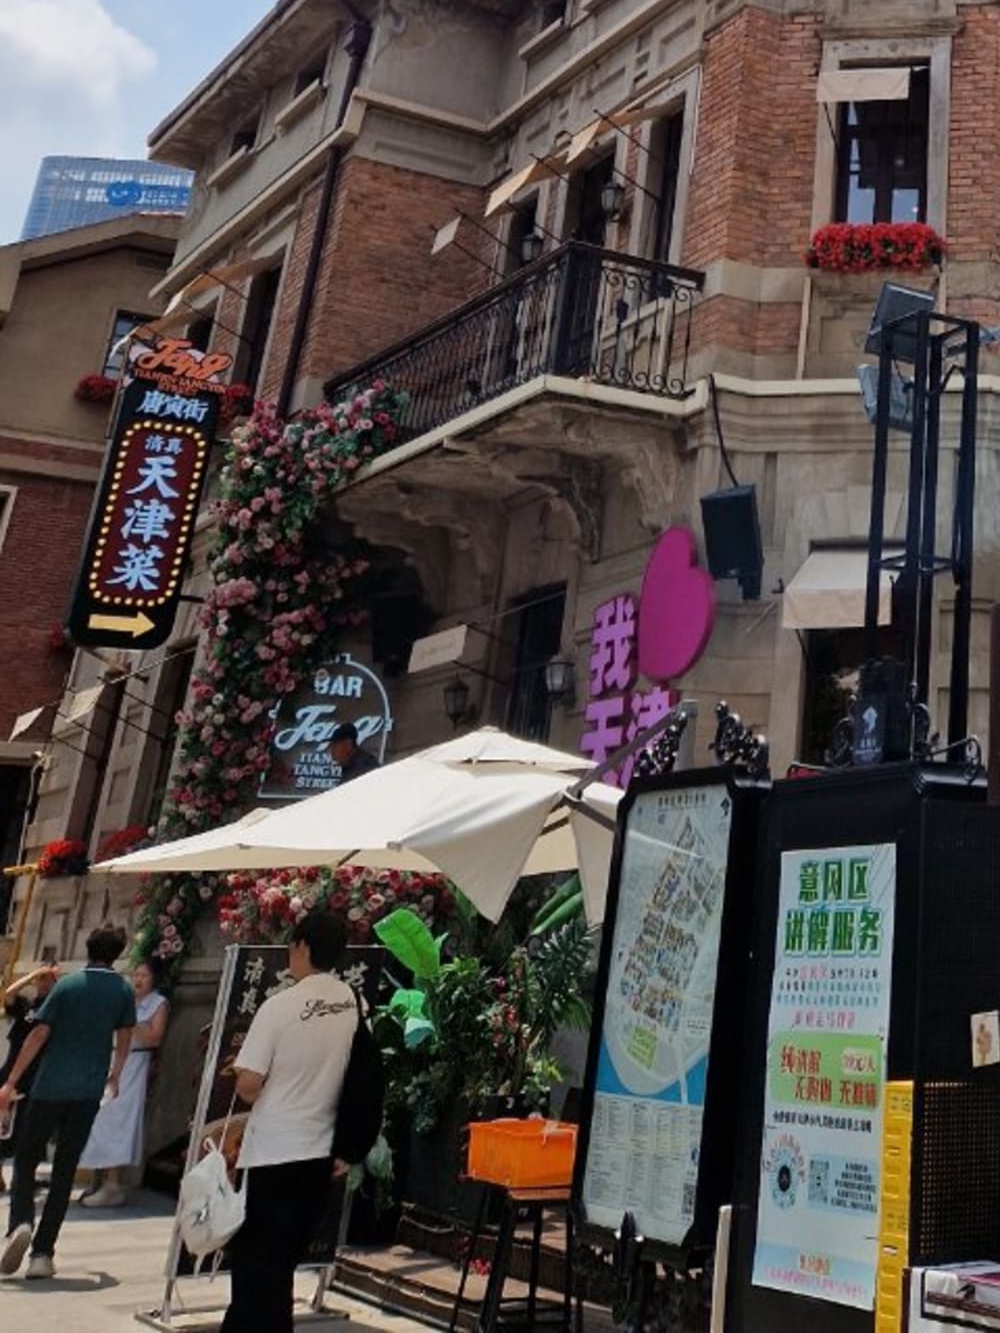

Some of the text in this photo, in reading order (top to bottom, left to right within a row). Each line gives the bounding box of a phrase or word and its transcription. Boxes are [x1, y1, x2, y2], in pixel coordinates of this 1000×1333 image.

[136, 389, 209, 423] 唐寅街
[105, 455, 180, 591] 天津菜
[589, 595, 636, 696] 我
[314, 671, 364, 699] BAR
[799, 859, 869, 903] 意风区
[784, 907, 882, 953] 讲解服务
